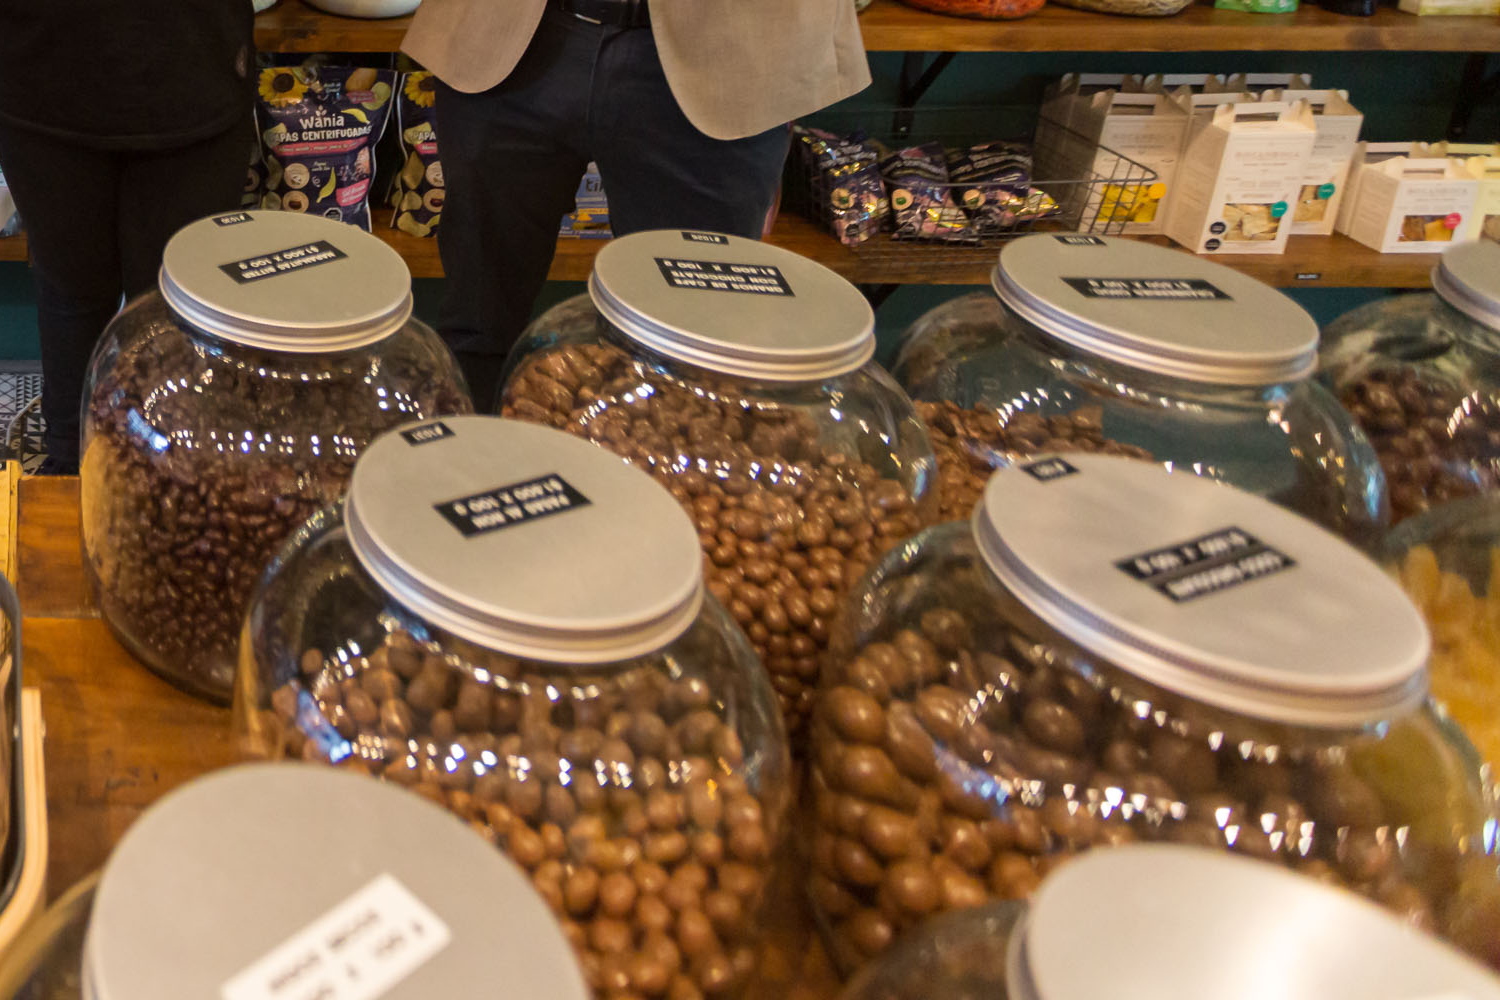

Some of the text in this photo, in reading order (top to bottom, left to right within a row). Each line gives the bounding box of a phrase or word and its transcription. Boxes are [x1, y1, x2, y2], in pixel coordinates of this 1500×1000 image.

[302, 125, 372, 140] CENTRIFUGADAS
[676, 261, 702, 270] 100
[671, 270, 778, 285] CON CHOCOLATE
[731, 283, 784, 293] GRANOS
